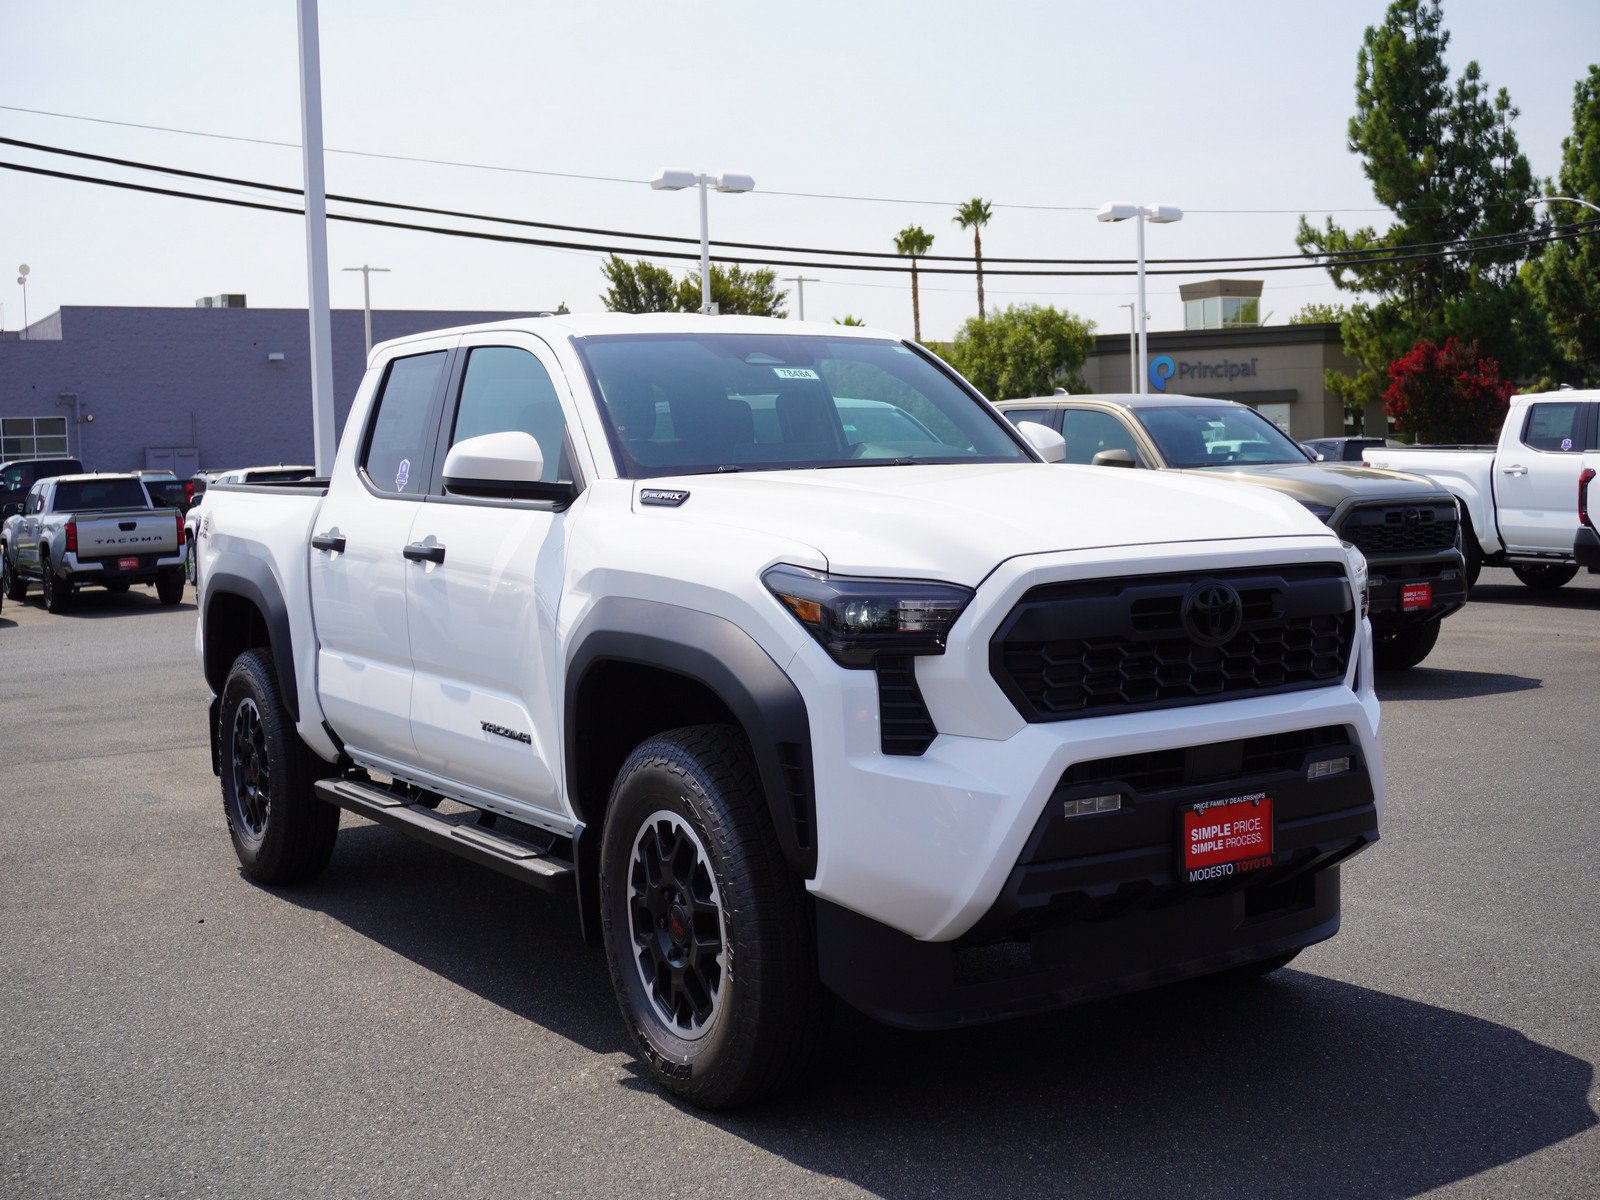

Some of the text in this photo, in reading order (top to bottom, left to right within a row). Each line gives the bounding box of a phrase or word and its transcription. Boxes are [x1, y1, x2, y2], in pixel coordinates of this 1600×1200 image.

[779, 369, 812, 378] 78484
[1178, 358, 1258, 381] Principal
[94, 536, 163, 545] TACOMA
[480, 720, 532, 745] TACOMA
[1193, 792, 1266, 810] PRICE FAMILY DEALERSHIPS
[1191, 817, 1263, 841] SIMPLE PRICE.
[1191, 832, 1264, 854] SIMPLE PROCESS.
[1189, 856, 1273, 882] MODESTO TOYOTA
